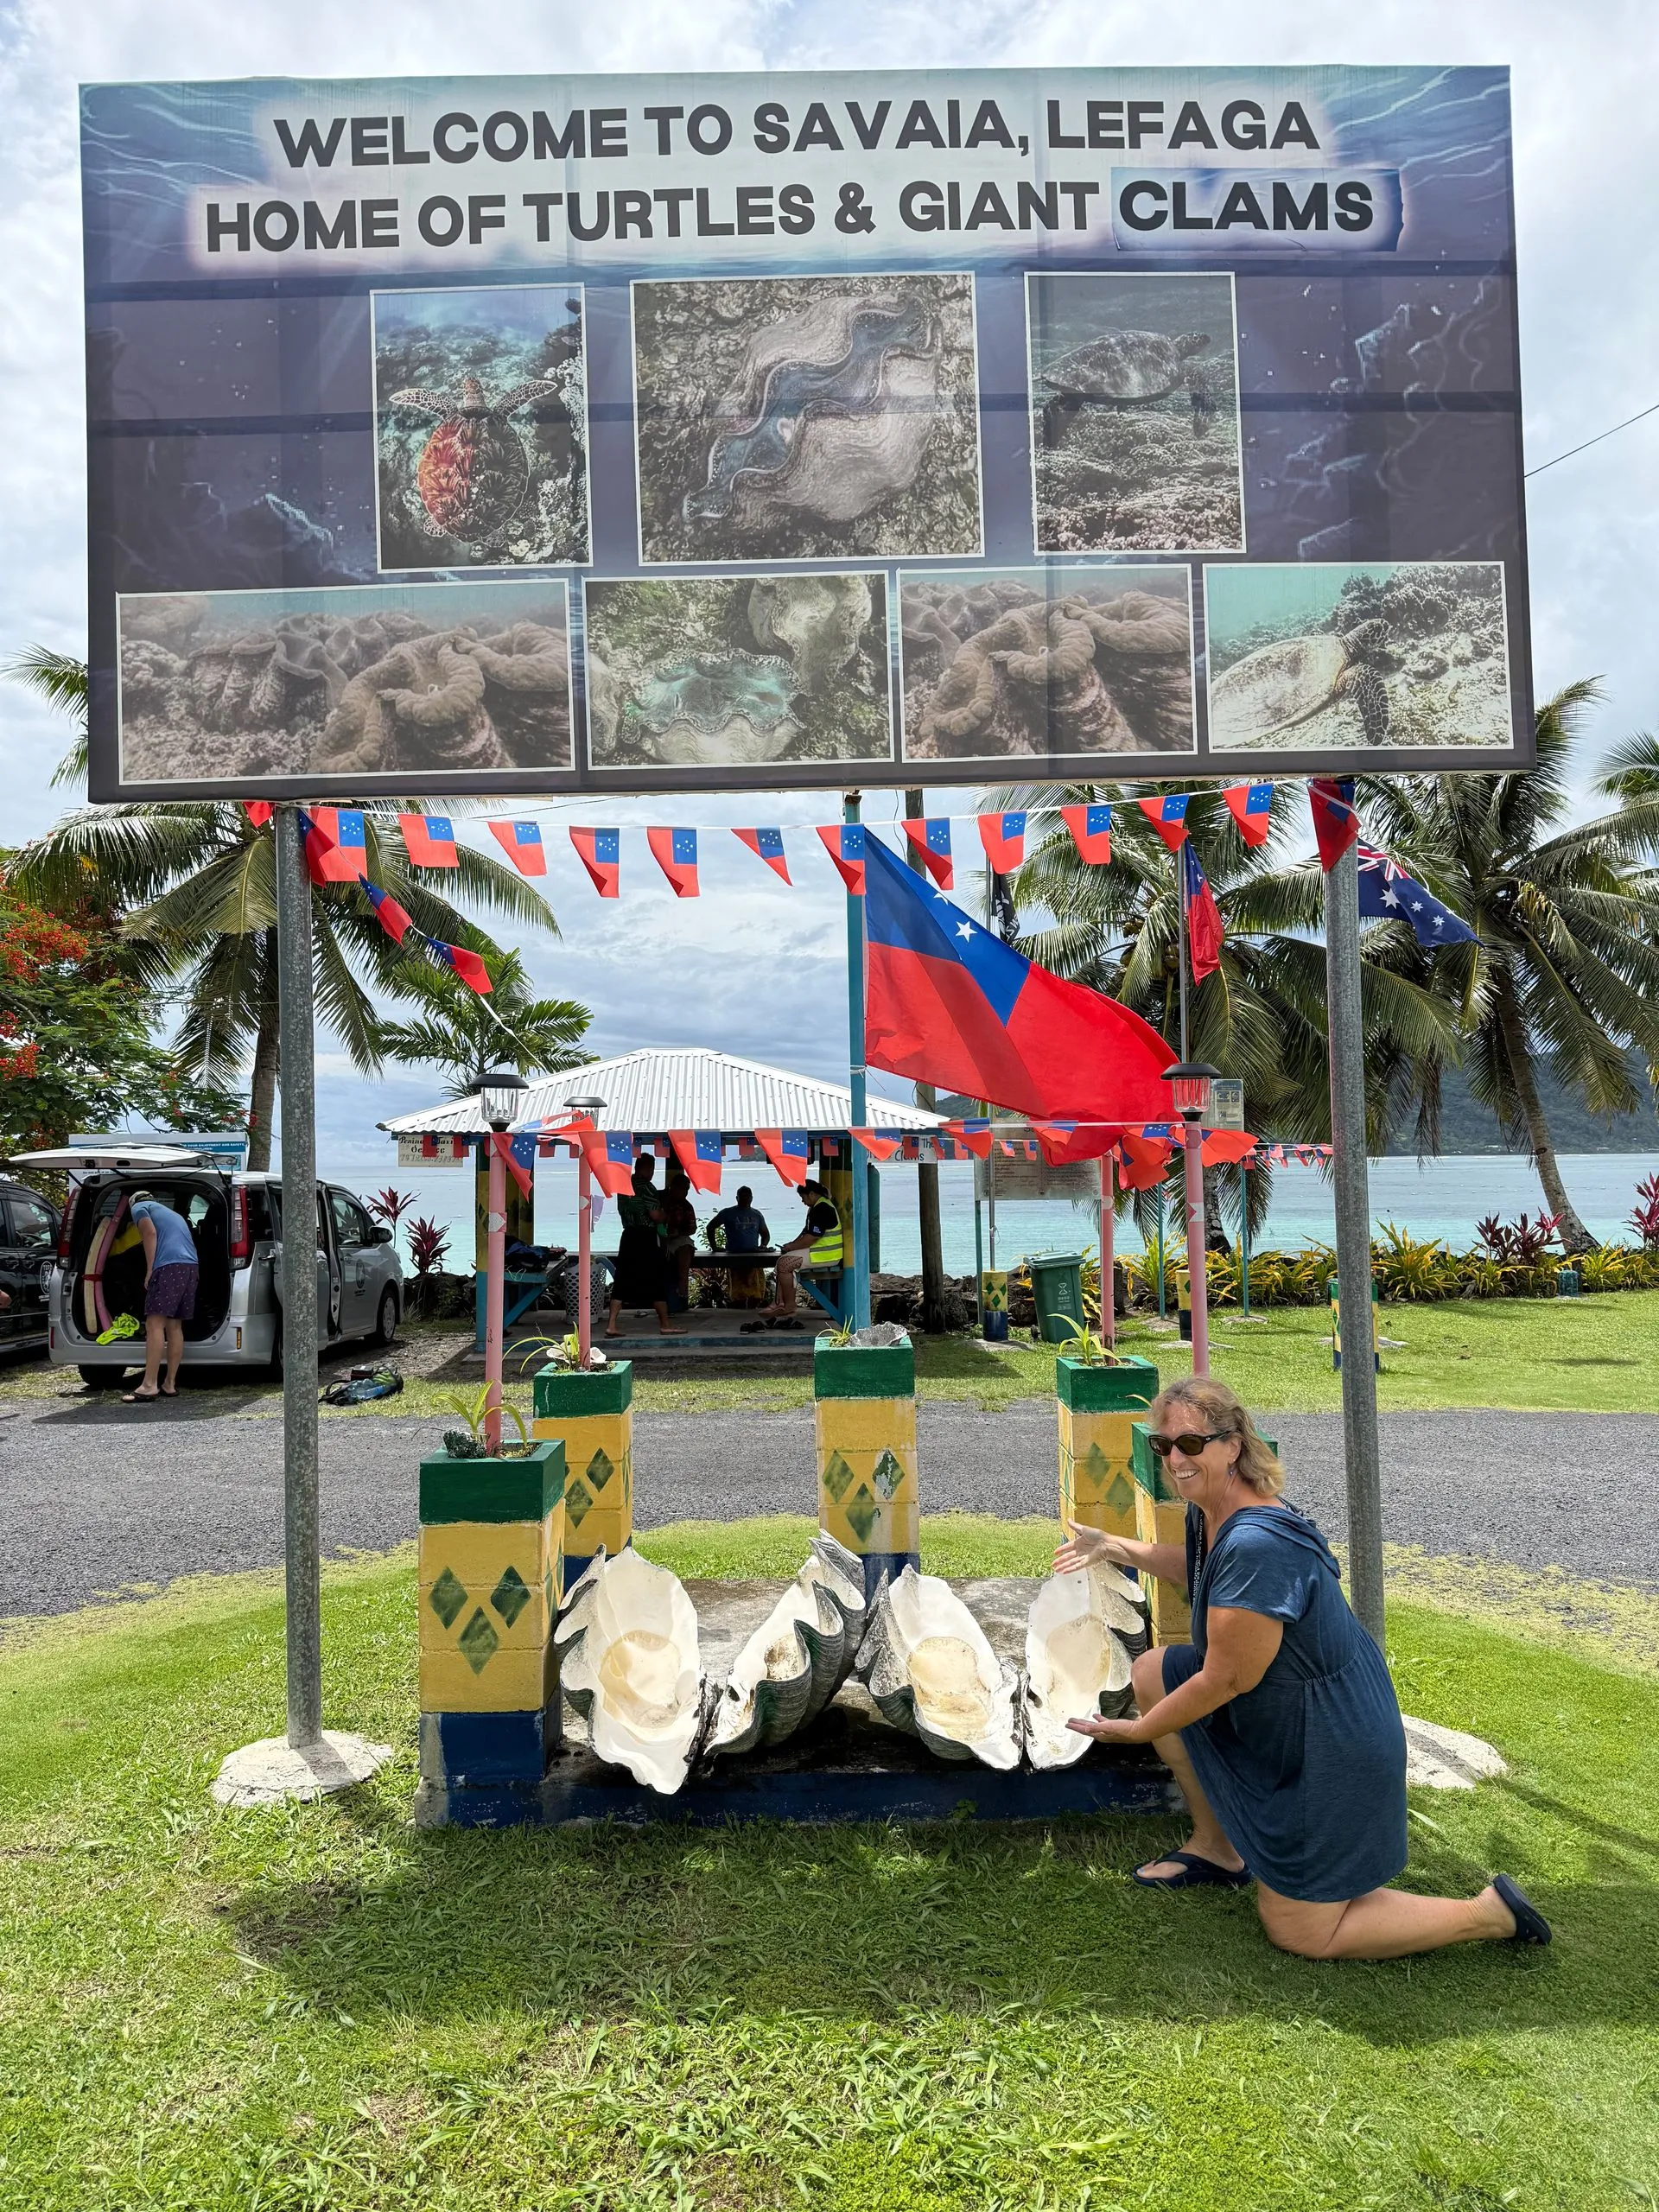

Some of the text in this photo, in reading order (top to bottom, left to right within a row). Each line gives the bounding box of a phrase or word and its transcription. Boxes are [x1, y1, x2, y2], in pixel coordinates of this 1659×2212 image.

[272, 99, 1322, 169] WELCOME TO SAVAIA, LEFAGA
[206, 179, 1375, 253] HOME OF TURTLES & GIANT CLAMS
